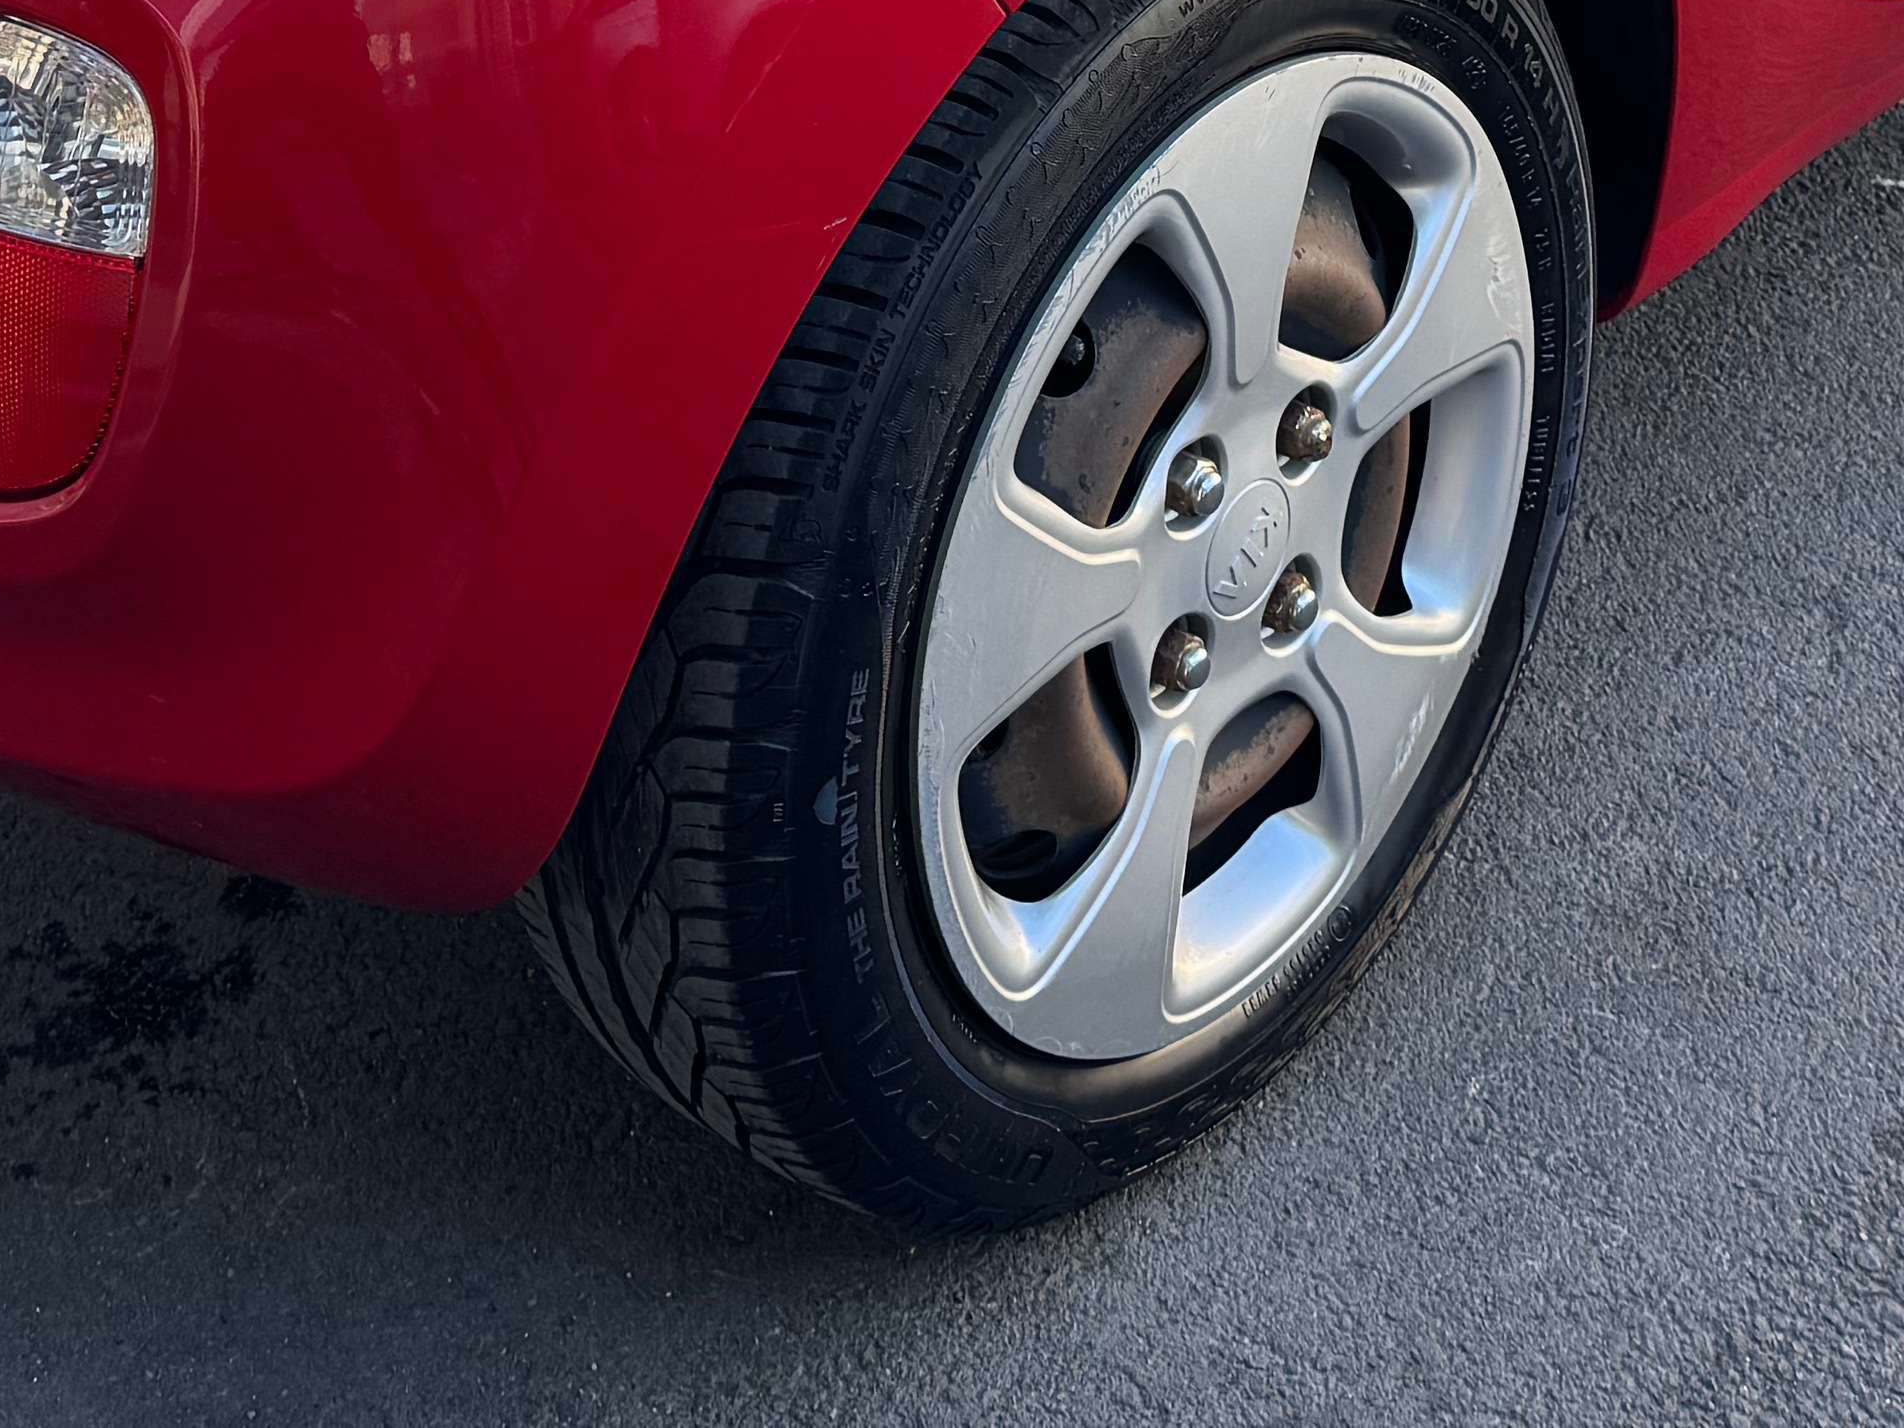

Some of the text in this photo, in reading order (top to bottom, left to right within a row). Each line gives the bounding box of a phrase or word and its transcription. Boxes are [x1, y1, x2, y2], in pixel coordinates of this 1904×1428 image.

[859, 328, 896, 393] SKIN
[892, 160, 985, 322] TECHNOLOGY
[1211, 505, 1278, 600] KIA
[847, 907, 875, 984] THE
